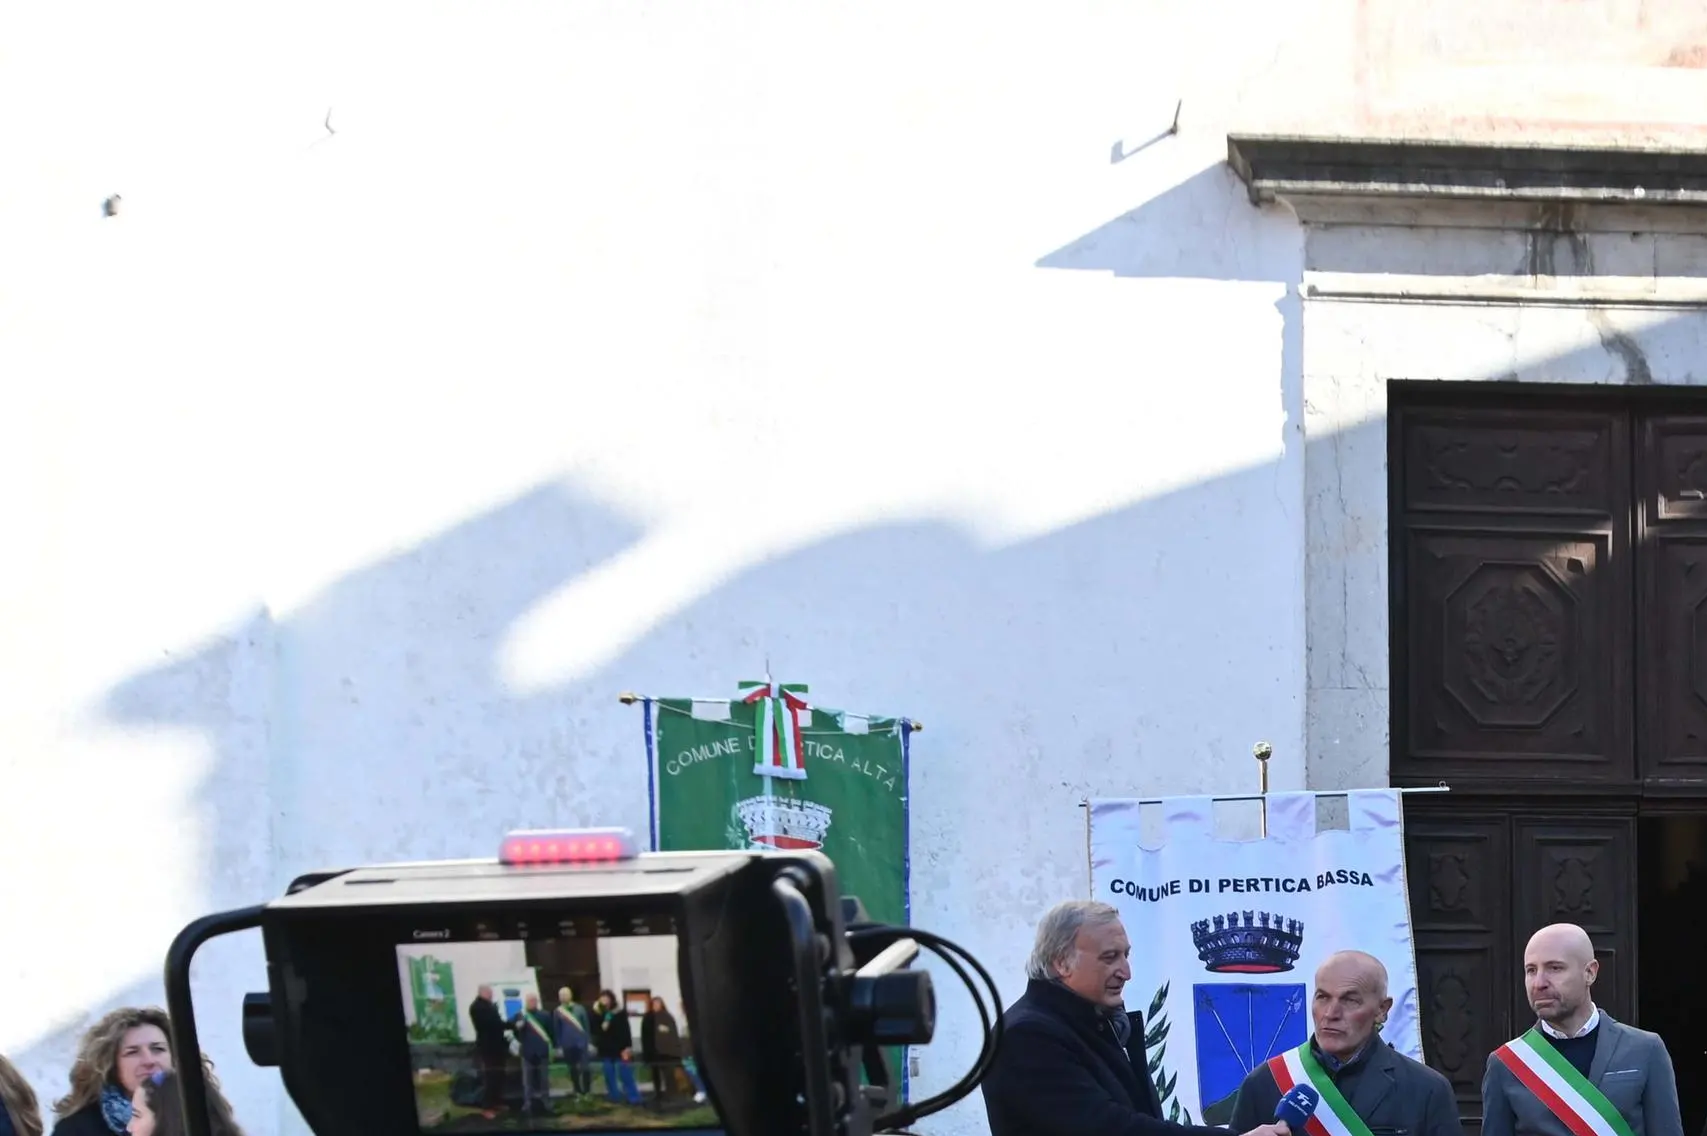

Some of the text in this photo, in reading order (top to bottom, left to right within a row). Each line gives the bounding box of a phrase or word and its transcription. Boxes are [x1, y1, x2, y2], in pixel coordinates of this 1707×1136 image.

[665, 736, 741, 776] COMUNE
[850, 757, 897, 793] ALTA
[1110, 868, 1374, 903] COMUNE DI PERTICA BASSA
